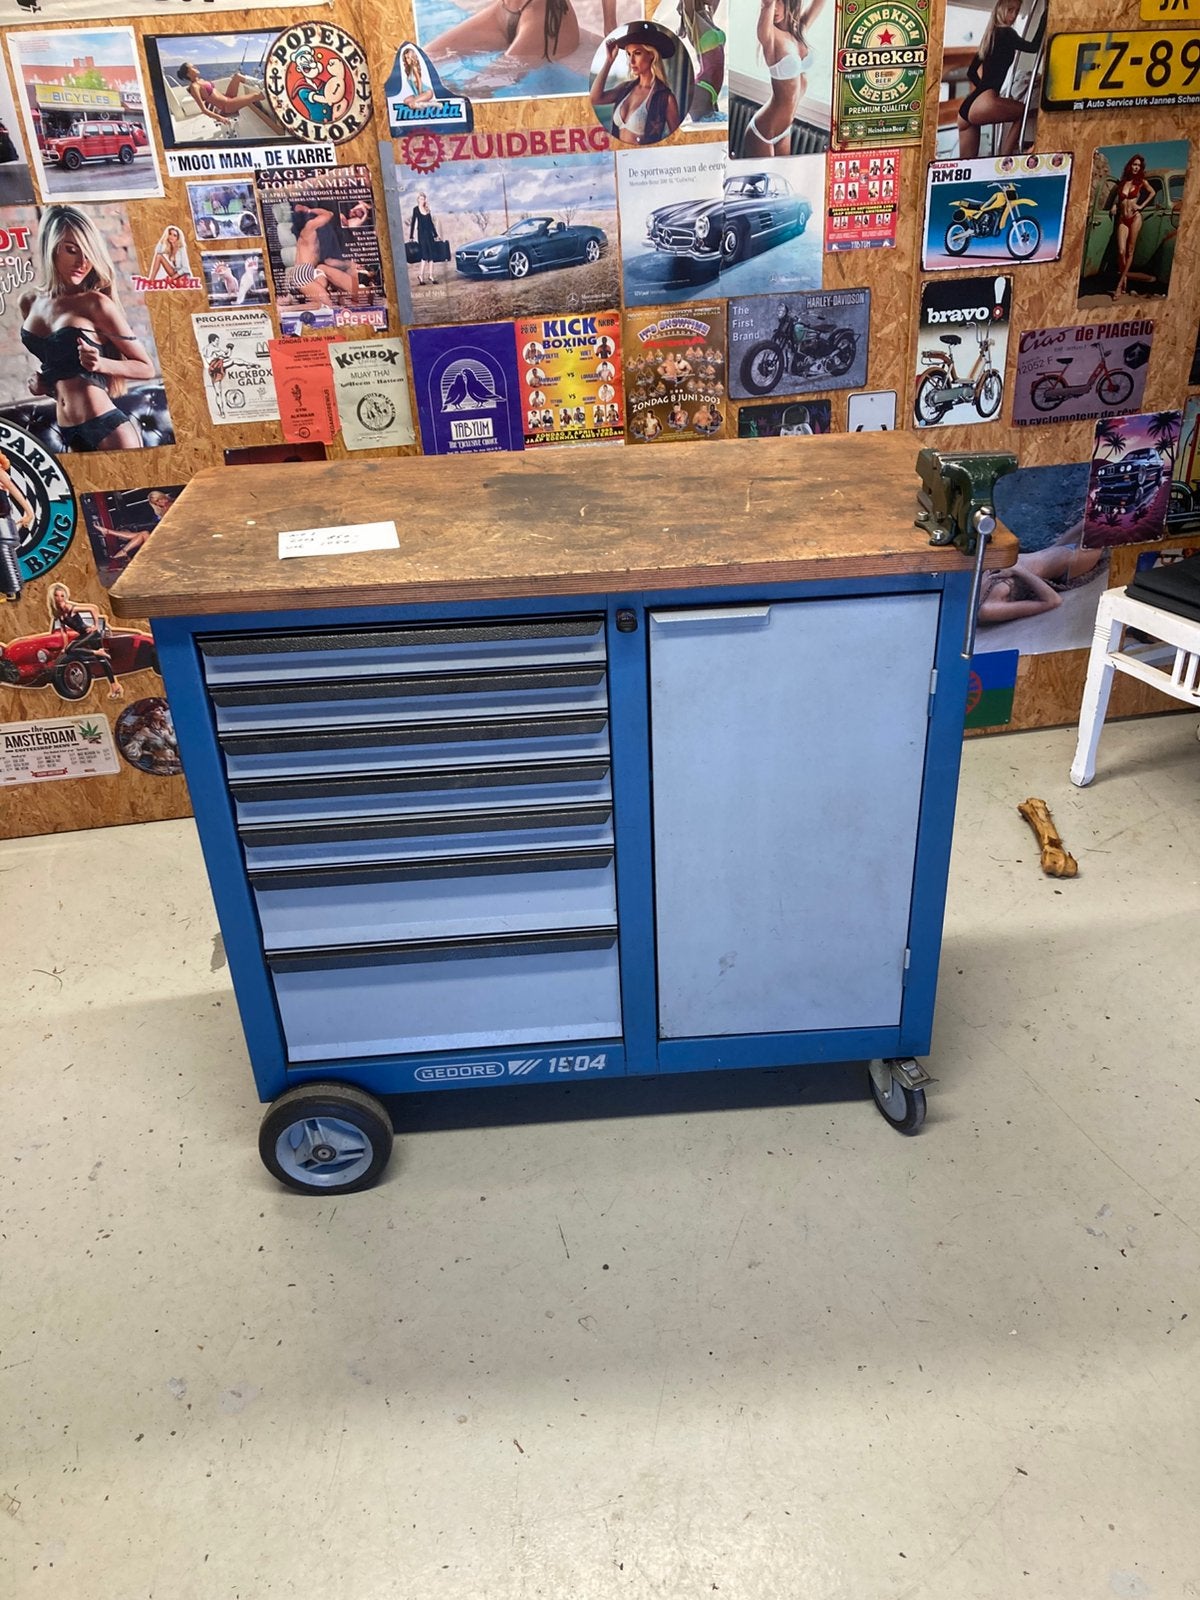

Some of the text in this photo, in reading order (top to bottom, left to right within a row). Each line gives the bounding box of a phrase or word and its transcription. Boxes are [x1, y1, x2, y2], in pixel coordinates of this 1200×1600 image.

[273, 27, 364, 70] POPEYE
[52, 91, 110, 104] BICYCLES
[1086, 100, 1105, 108] Auto
[1106, 98, 1134, 107] Service
[1135, 97, 1148, 105] Urk
[1149, 96, 1176, 105] Jannes
[848, 104, 909, 114] PREMIUM QUALITY
[282, 108, 361, 140] SALOR
[450, 127, 610, 161] ZUIDBERG
[265, 150, 284, 166] DE
[287, 147, 334, 165] KARRE
[260, 166, 367, 181] CAGE-FIGHT
[629, 162, 727, 178] De sportwagen van de eeuw
[261, 177, 367, 190] TOURNAMENT
[807, 293, 865, 308] HARLEY-DAVIDSON
[195, 313, 268, 323] PROGRAMMA
[732, 306, 750, 315] The
[360, 311, 384, 326] FUN
[732, 319, 754, 328] First
[543, 317, 598, 338] KICK
[542, 336, 597, 349] BOXING
[732, 331, 760, 341] Brand
[1019, 328, 1074, 353] Ciao
[1075, 326, 1094, 342] de
[1097, 321, 1153, 340] PIAGGIO
[335, 349, 399, 369] KICKBOX
[227, 369, 273, 380] KICKBOX
[350, 369, 390, 379] MUAY THAI
[237, 378, 266, 386] GALA
[632, 396, 668, 413] ZONDAG
[677, 393, 697, 402] JUNI
[700, 394, 720, 405] 2003
[1028, 412, 1099, 425] cyclomoteur
[1101, 410, 1114, 419] de
[453, 421, 490, 438] YAB YUM
[24, 513, 72, 574] BANG
[4, 730, 77, 748] AMSTERDAM
[421, 1064, 497, 1080] GEDORE
